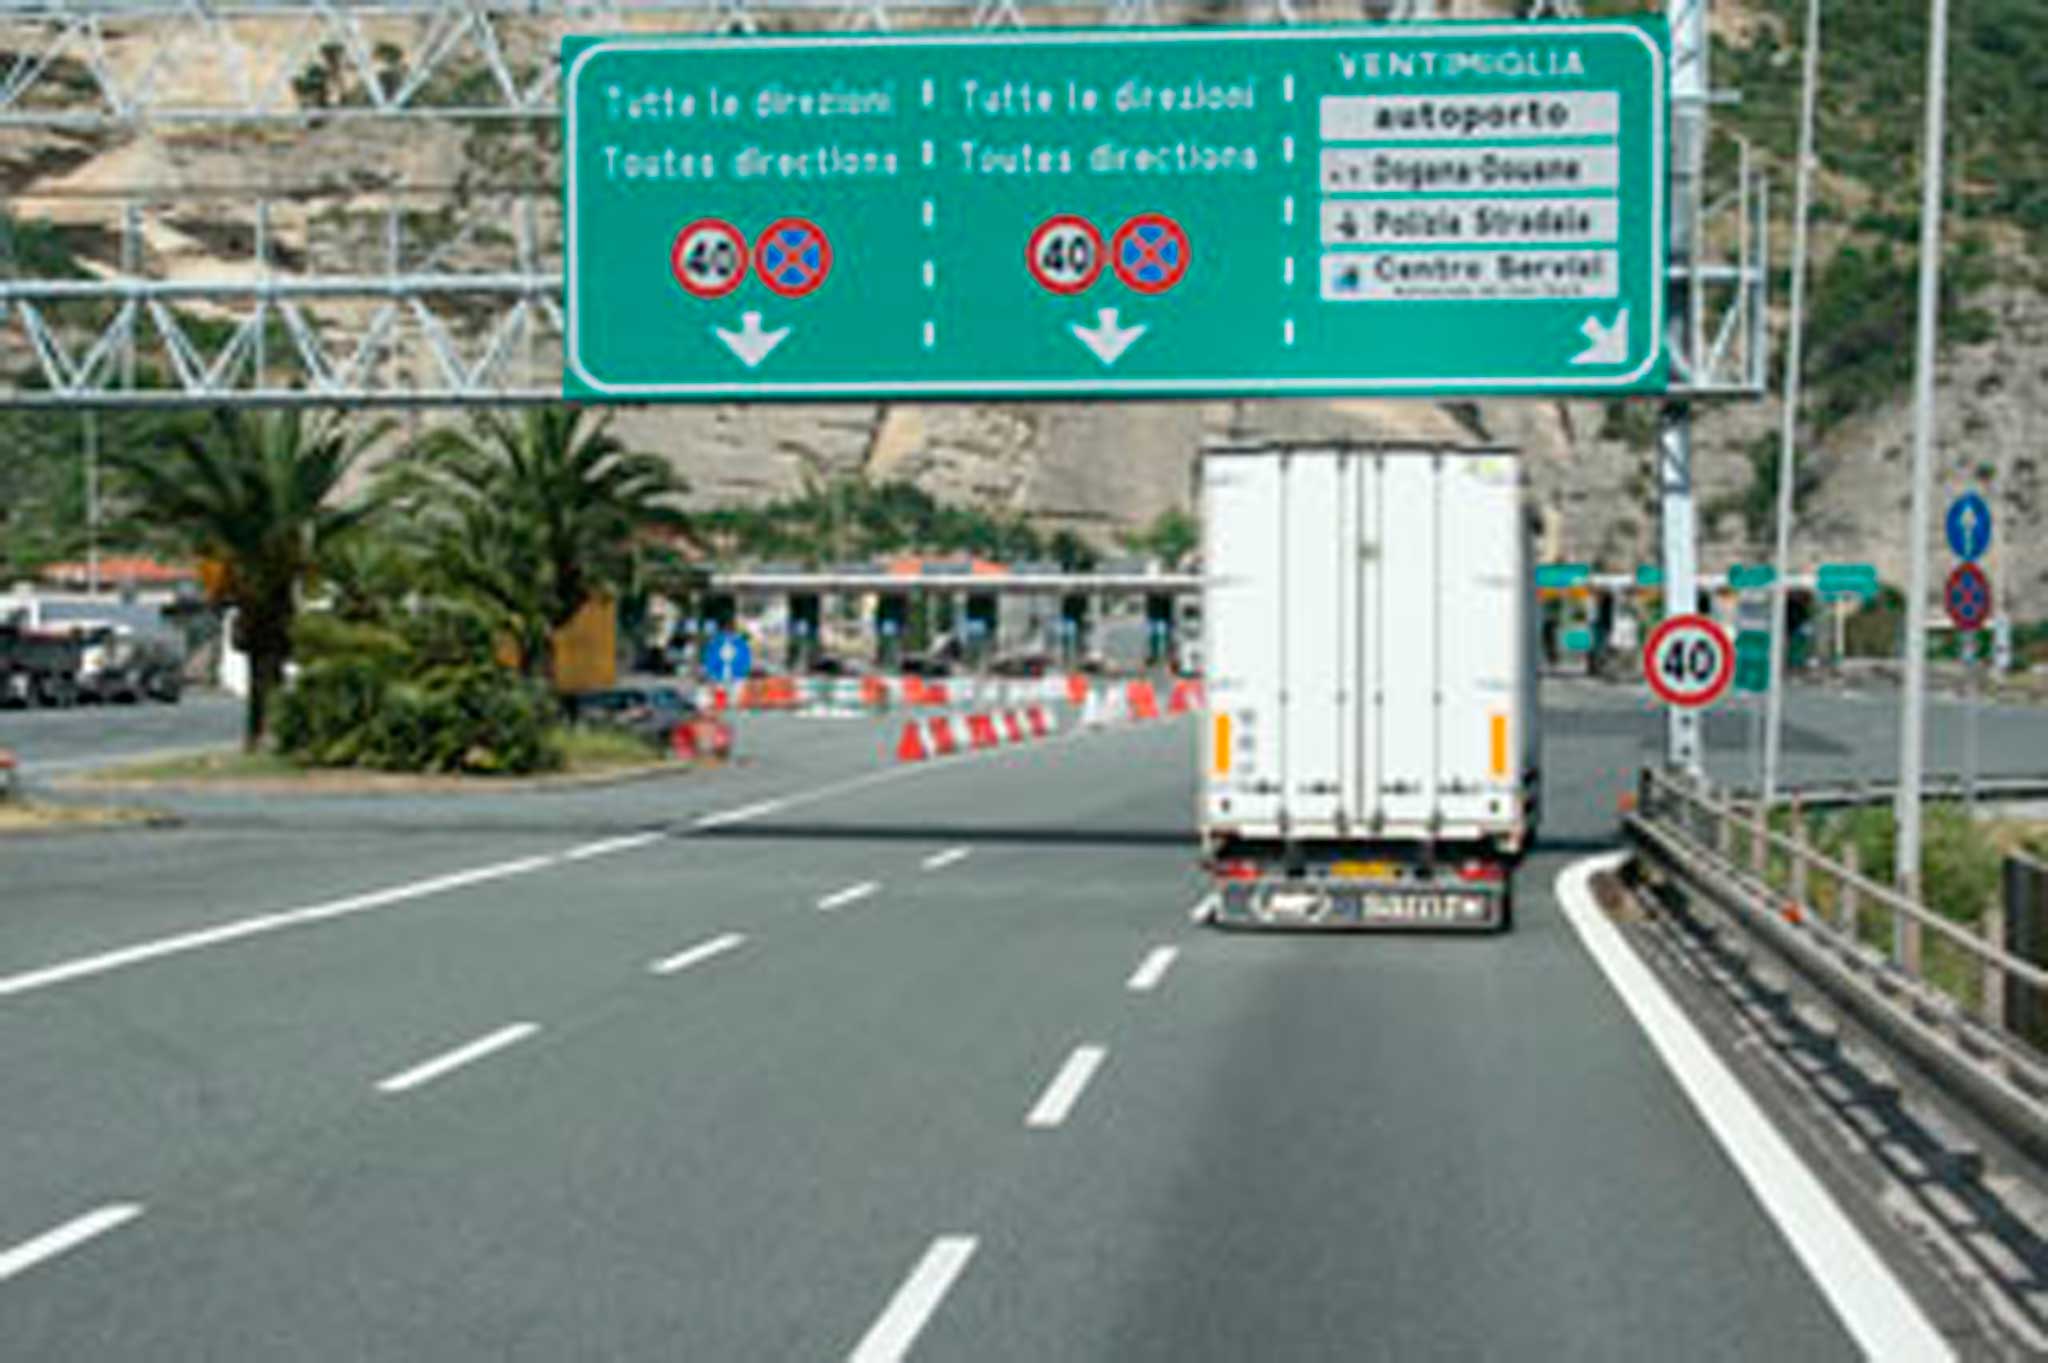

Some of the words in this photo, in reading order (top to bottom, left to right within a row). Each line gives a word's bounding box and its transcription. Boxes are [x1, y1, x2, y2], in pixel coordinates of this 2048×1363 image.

[1339, 51, 1584, 79] VENTIMIGLIA
[605, 84, 696, 120] Tutte
[710, 84, 739, 118] le
[756, 81, 892, 119] direzioni
[964, 79, 1053, 114] Tutte
[1068, 80, 1098, 112] le
[1115, 78, 1255, 112] direzioni
[1374, 99, 1570, 135] autoporto
[604, 144, 714, 179] Toutes
[734, 143, 898, 179] directions
[961, 140, 1072, 174] Toutes
[1090, 138, 1258, 174] directions
[1373, 207, 1461, 238] Polizia
[1475, 205, 1591, 236] Stradale
[686, 240, 740, 278] 40
[1042, 235, 1096, 275] 40
[1374, 255, 1481, 282] Centro
[1663, 638, 1717, 683] 40
